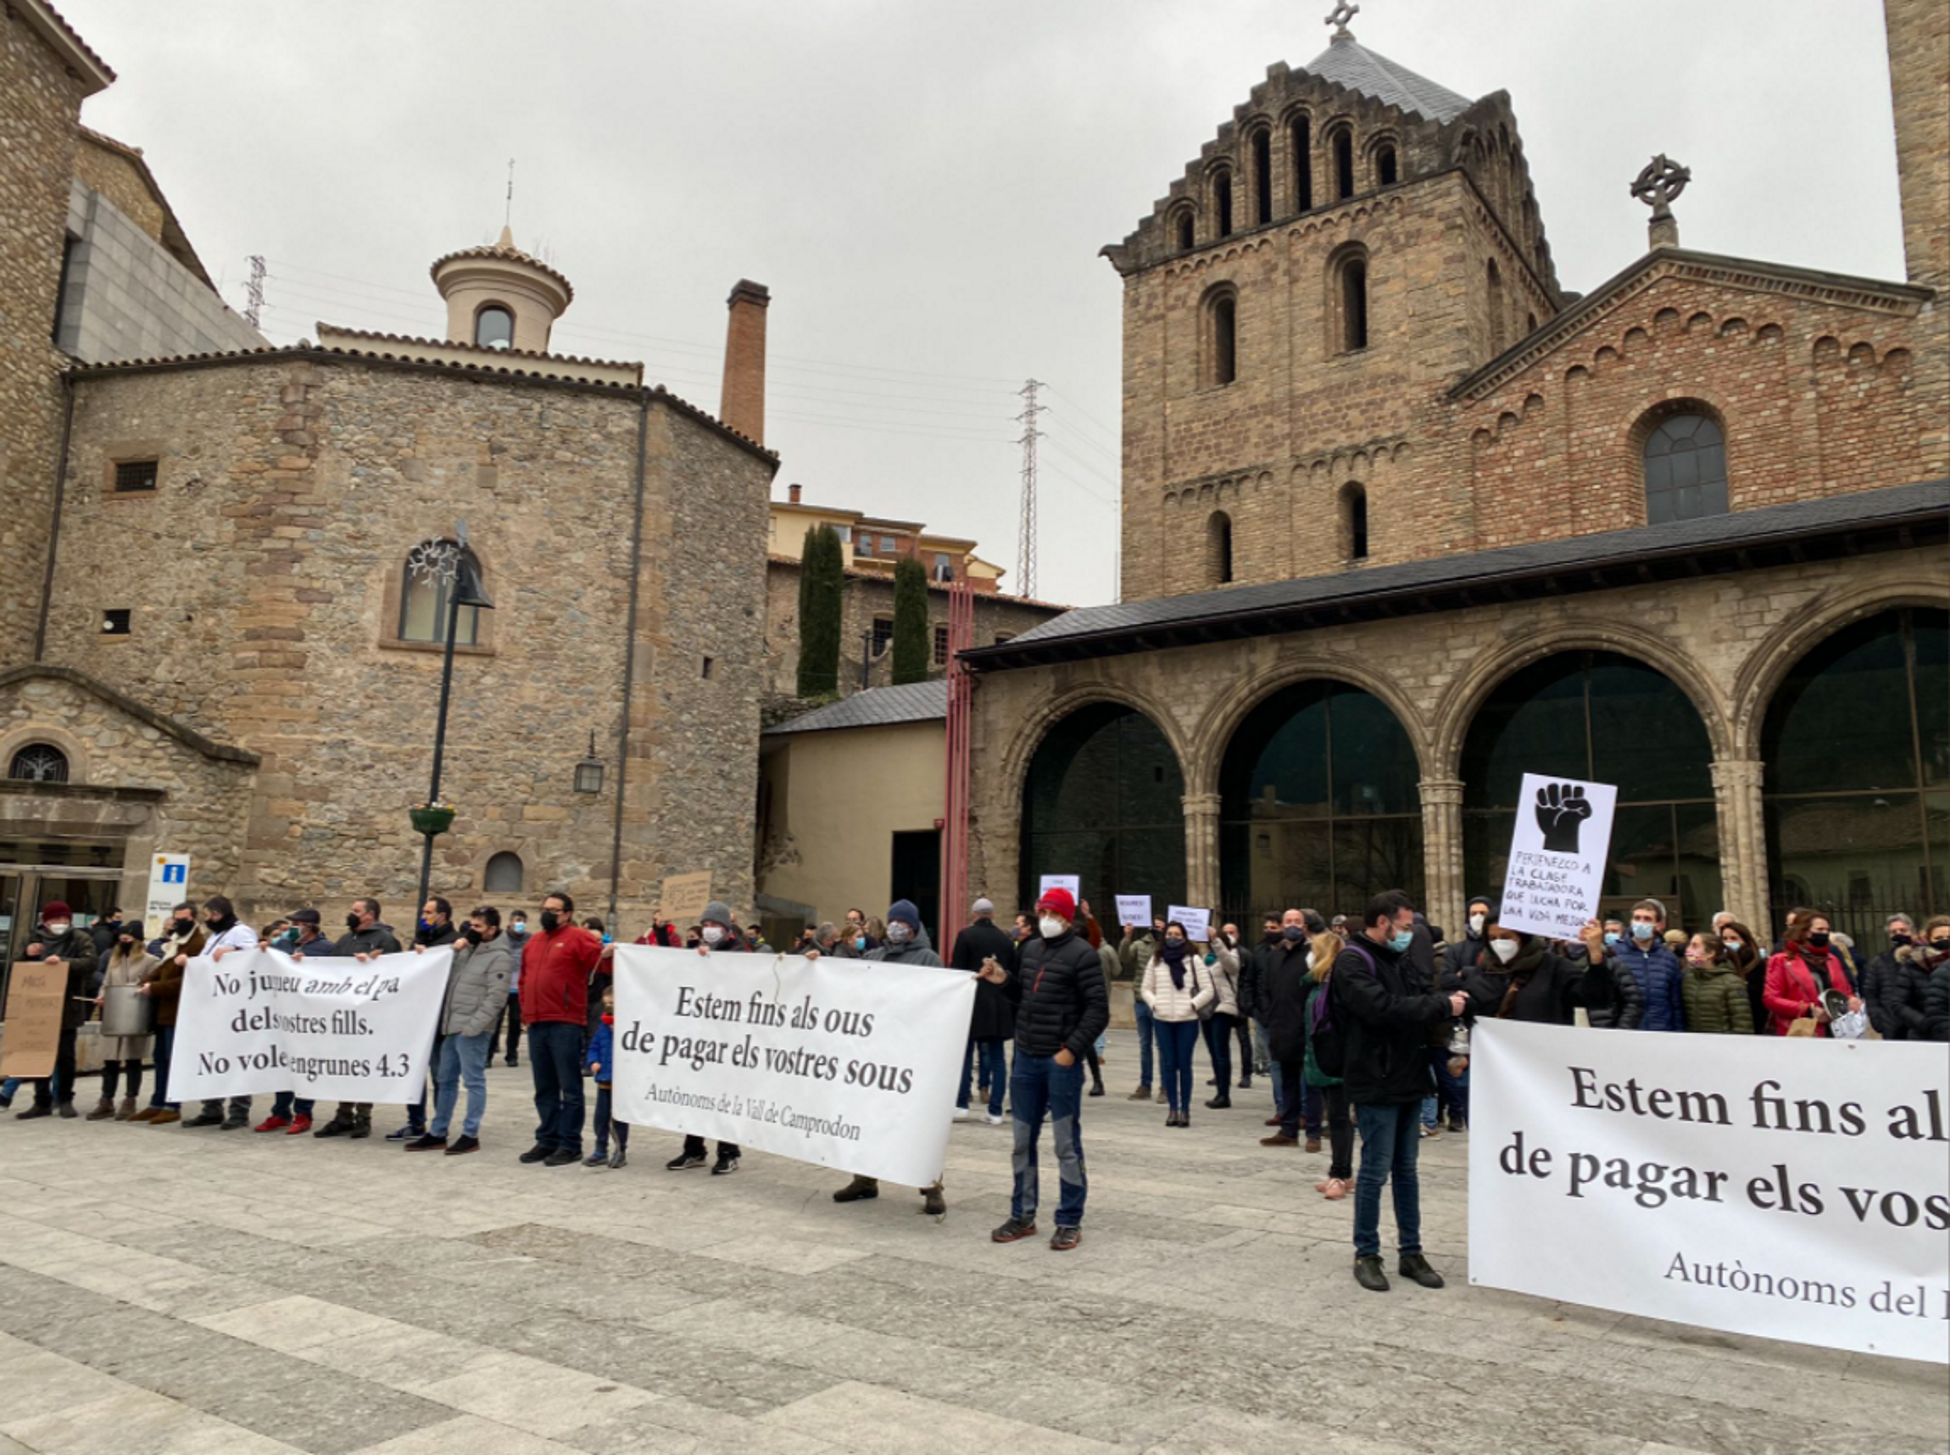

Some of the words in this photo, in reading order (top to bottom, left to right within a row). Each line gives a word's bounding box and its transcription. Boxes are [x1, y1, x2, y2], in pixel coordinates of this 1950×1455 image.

[1511, 865, 1524, 876] LA
[1582, 862, 1591, 874] A
[1503, 905, 1523, 918] UNA
[1529, 909, 1551, 922] VIDA
[1505, 890, 1525, 903] QUE
[1530, 894, 1561, 908] LUCHA
[213, 973, 241, 996] No
[305, 975, 352, 995] amb
[354, 974, 379, 995] el
[371, 977, 399, 1001] pa
[231, 1006, 279, 1032] dels
[332, 1010, 373, 1035] fills.
[675, 986, 741, 1023] Estem
[747, 991, 787, 1027] fins
[791, 995, 818, 1030] als
[825, 1007, 874, 1037] ous
[198, 1051, 230, 1075] No
[376, 1053, 410, 1077] 4.3
[621, 1021, 655, 1053] de
[658, 1032, 728, 1072] pagar
[732, 1034, 758, 1069] els
[764, 1045, 838, 1081] vostres
[844, 1058, 913, 1094] sous
[644, 1083, 716, 1111] Autònoms
[717, 1093, 731, 1114] de
[732, 1095, 743, 1116] la
[764, 1102, 778, 1124] de
[780, 1105, 860, 1141] Camprodon
[1567, 1065, 1733, 1126] Estem
[1749, 1080, 1867, 1137] fins
[1887, 1089, 1949, 1142] al
[1500, 1131, 1552, 1179] de
[1566, 1151, 1729, 1209] pagar
[1746, 1164, 1825, 1216] els
[1838, 1186, 1950, 1231] vos
[1663, 1251, 1857, 1308] Autònoms
[1868, 1281, 1929, 1318] del
